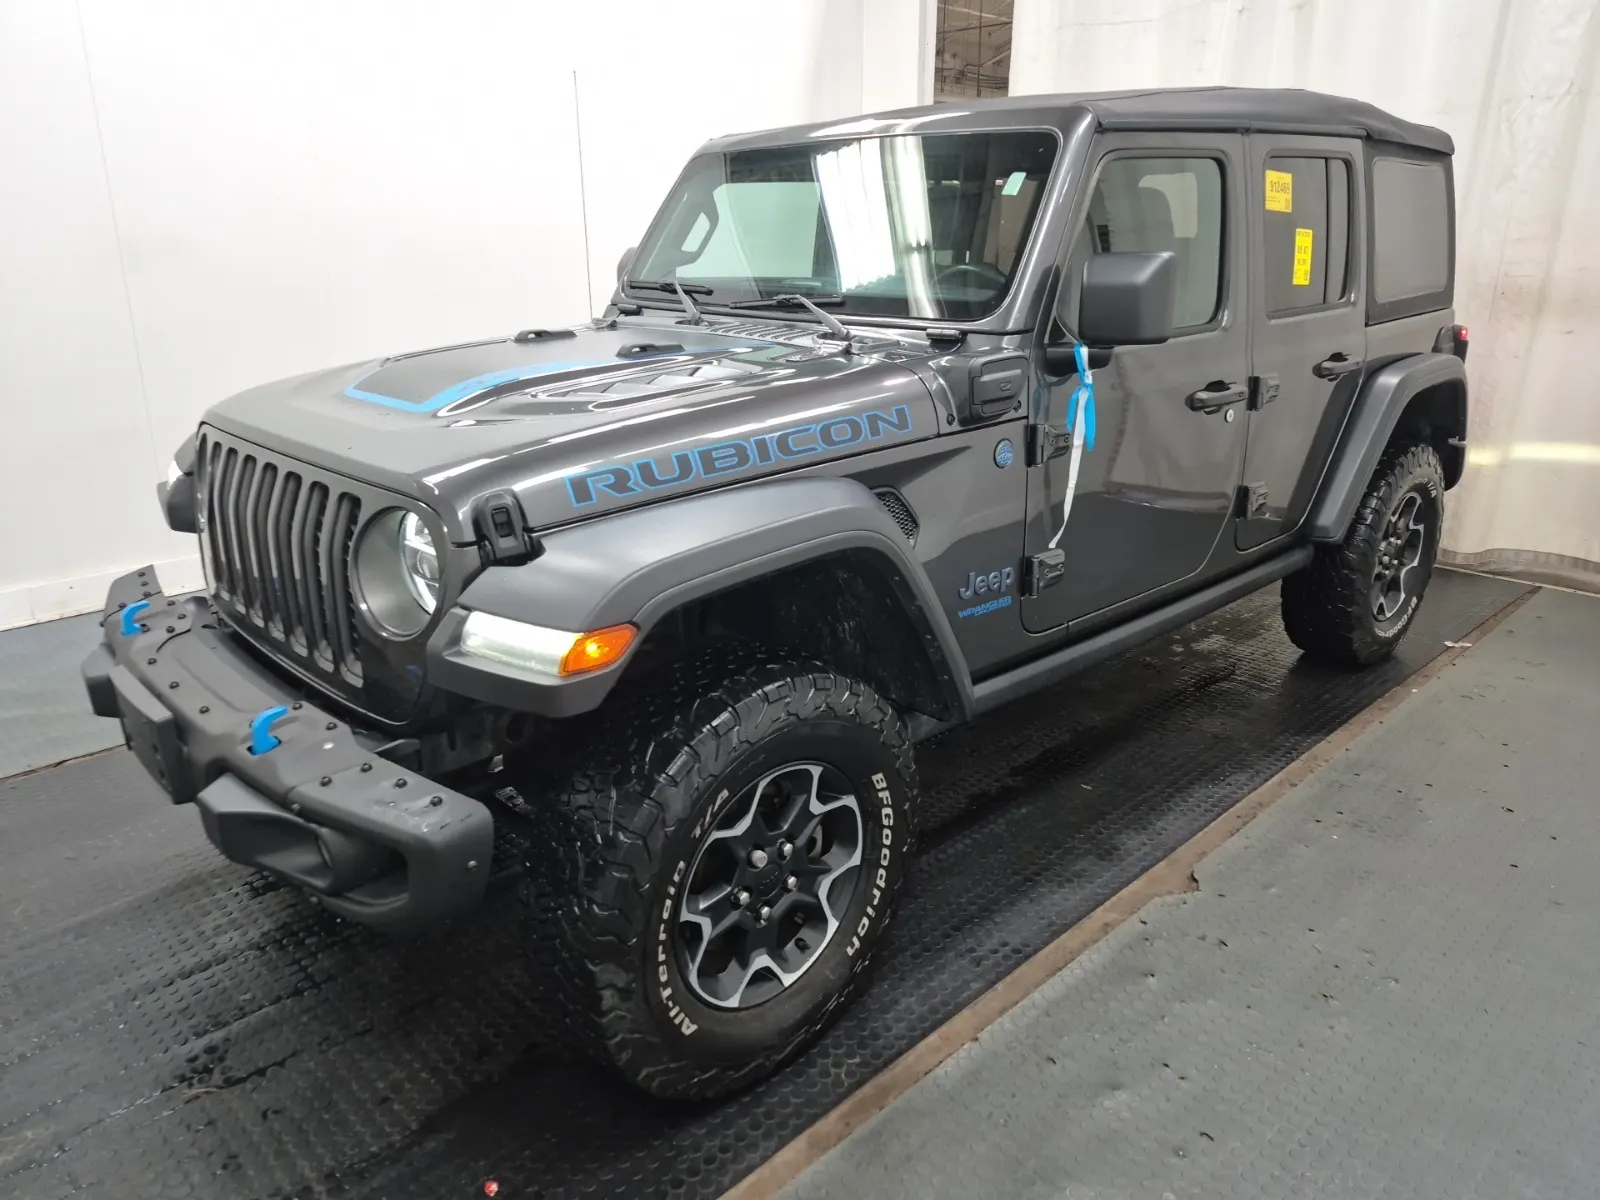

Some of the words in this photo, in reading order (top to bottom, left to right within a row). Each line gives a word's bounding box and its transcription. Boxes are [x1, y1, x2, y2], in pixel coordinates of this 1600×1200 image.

[563, 404, 913, 508] RUBICON
[958, 567, 1014, 600] Jeep
[958, 595, 1012, 619] WRANGLER
[845, 772, 895, 957] BFGoodrich
